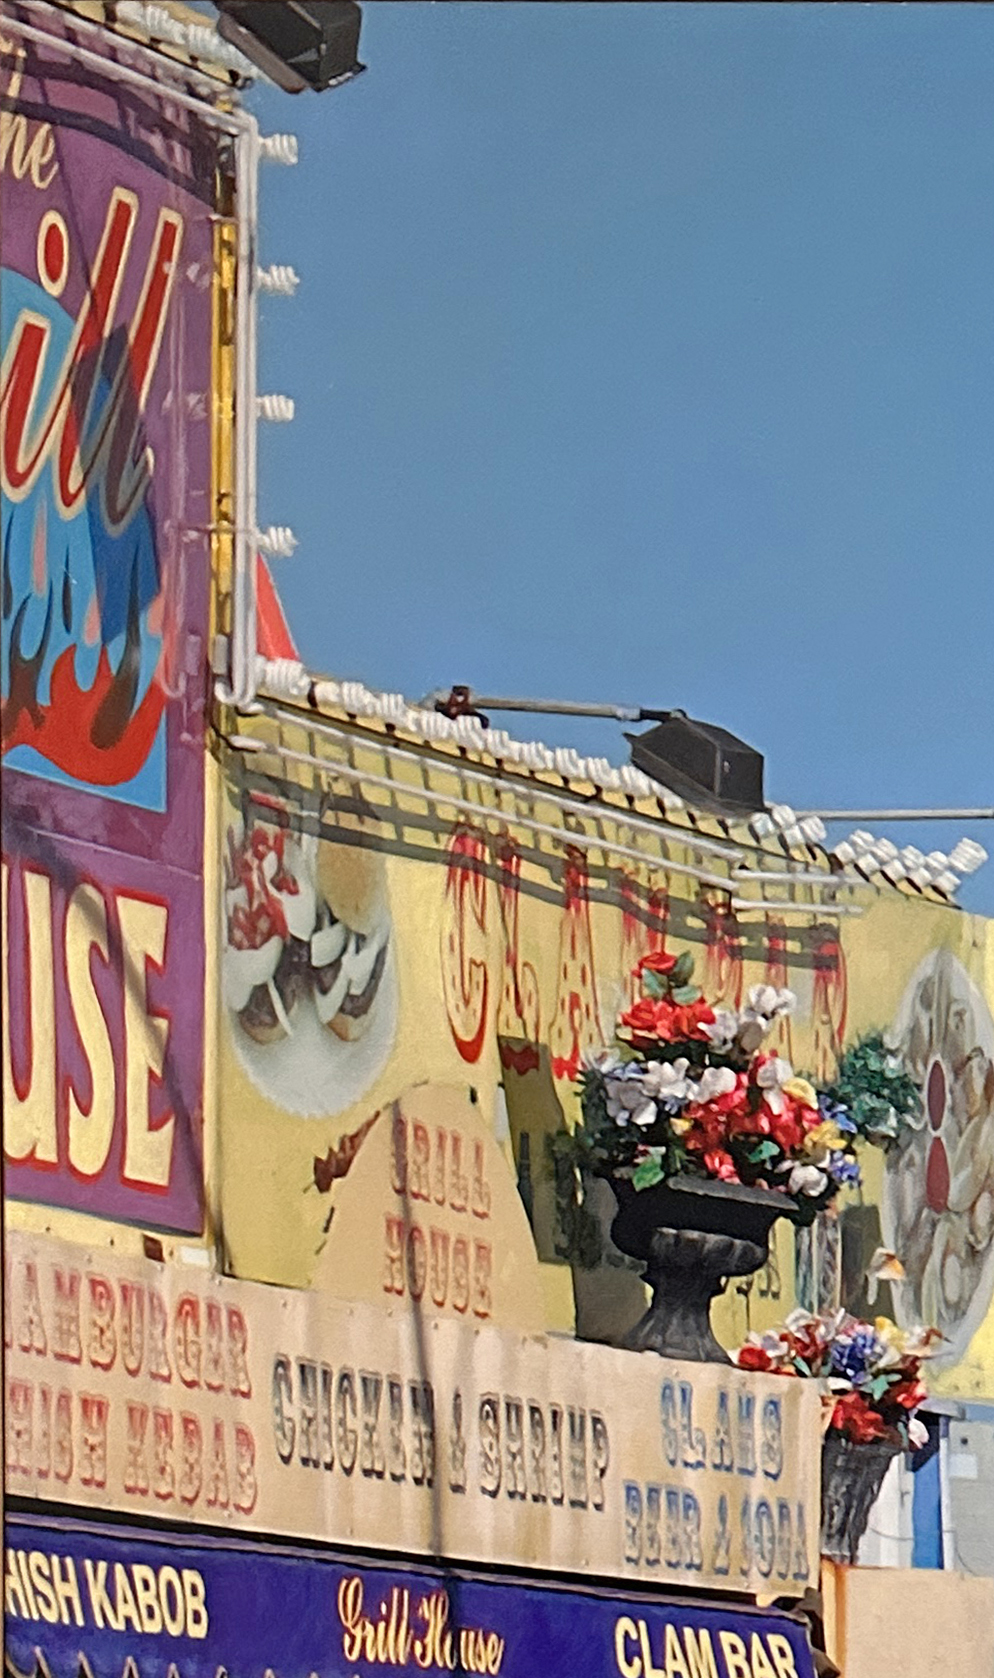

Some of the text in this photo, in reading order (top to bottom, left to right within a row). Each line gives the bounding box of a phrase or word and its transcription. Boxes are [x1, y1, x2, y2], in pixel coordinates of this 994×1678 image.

[4, 1250, 252, 1400] AMBURGER
[124, 1398, 259, 1516] KEBAB
[272, 1352, 436, 1490] CHICKEN
[479, 1391, 610, 1513] SHRIMP
[660, 1377, 783, 1482] CLAMS
[623, 1479, 704, 1572] BEER
[740, 1494, 810, 1581] SODA
[84, 1558, 209, 1640] KABOB
[337, 1575, 506, 1677] Grill House
